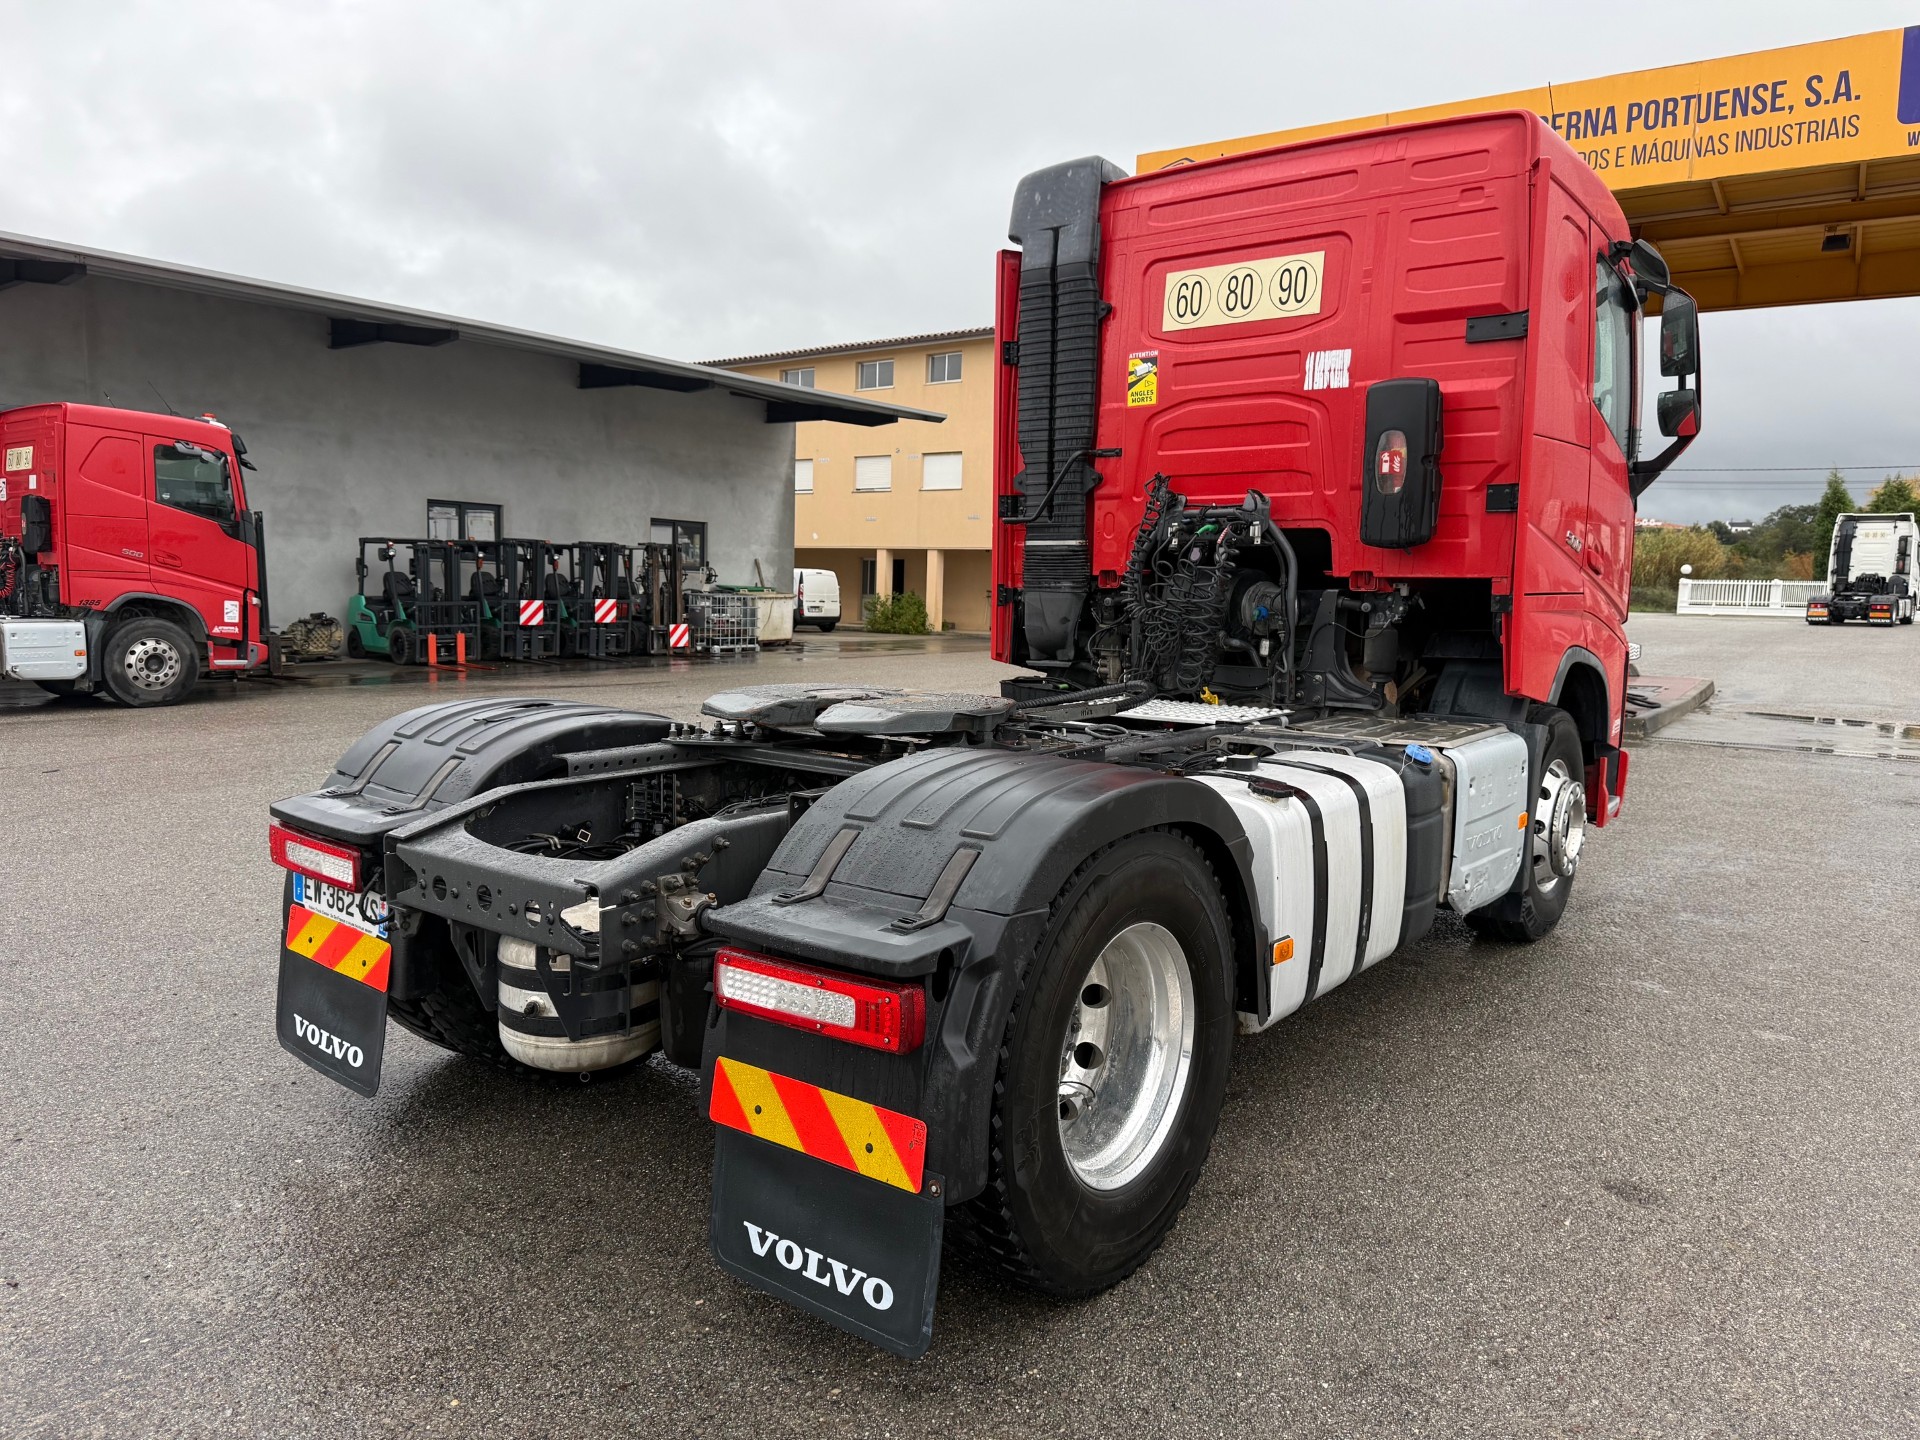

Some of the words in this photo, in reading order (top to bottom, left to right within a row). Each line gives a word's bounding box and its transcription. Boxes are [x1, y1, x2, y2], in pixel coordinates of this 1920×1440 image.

[1540, 105, 1617, 141] ERNA
[1626, 80, 1794, 133] PORTUENSE,
[1805, 70, 1861, 106] S.A.
[1615, 146, 1626, 168] E
[1631, 132, 1729, 167] MÁQUINAS
[1735, 114, 1860, 150] INDUSTRIAIS
[1176, 280, 1203, 319] 60
[1226, 273, 1254, 312] 80
[1279, 265, 1308, 305] 90
[1129, 350, 1158, 359] ATTENTION
[1130, 389, 1154, 398] ANGLES
[121, 548, 144, 558] 500
[293, 1013, 364, 1068] VOLVO
[743, 1220, 895, 1311] VOLVO
